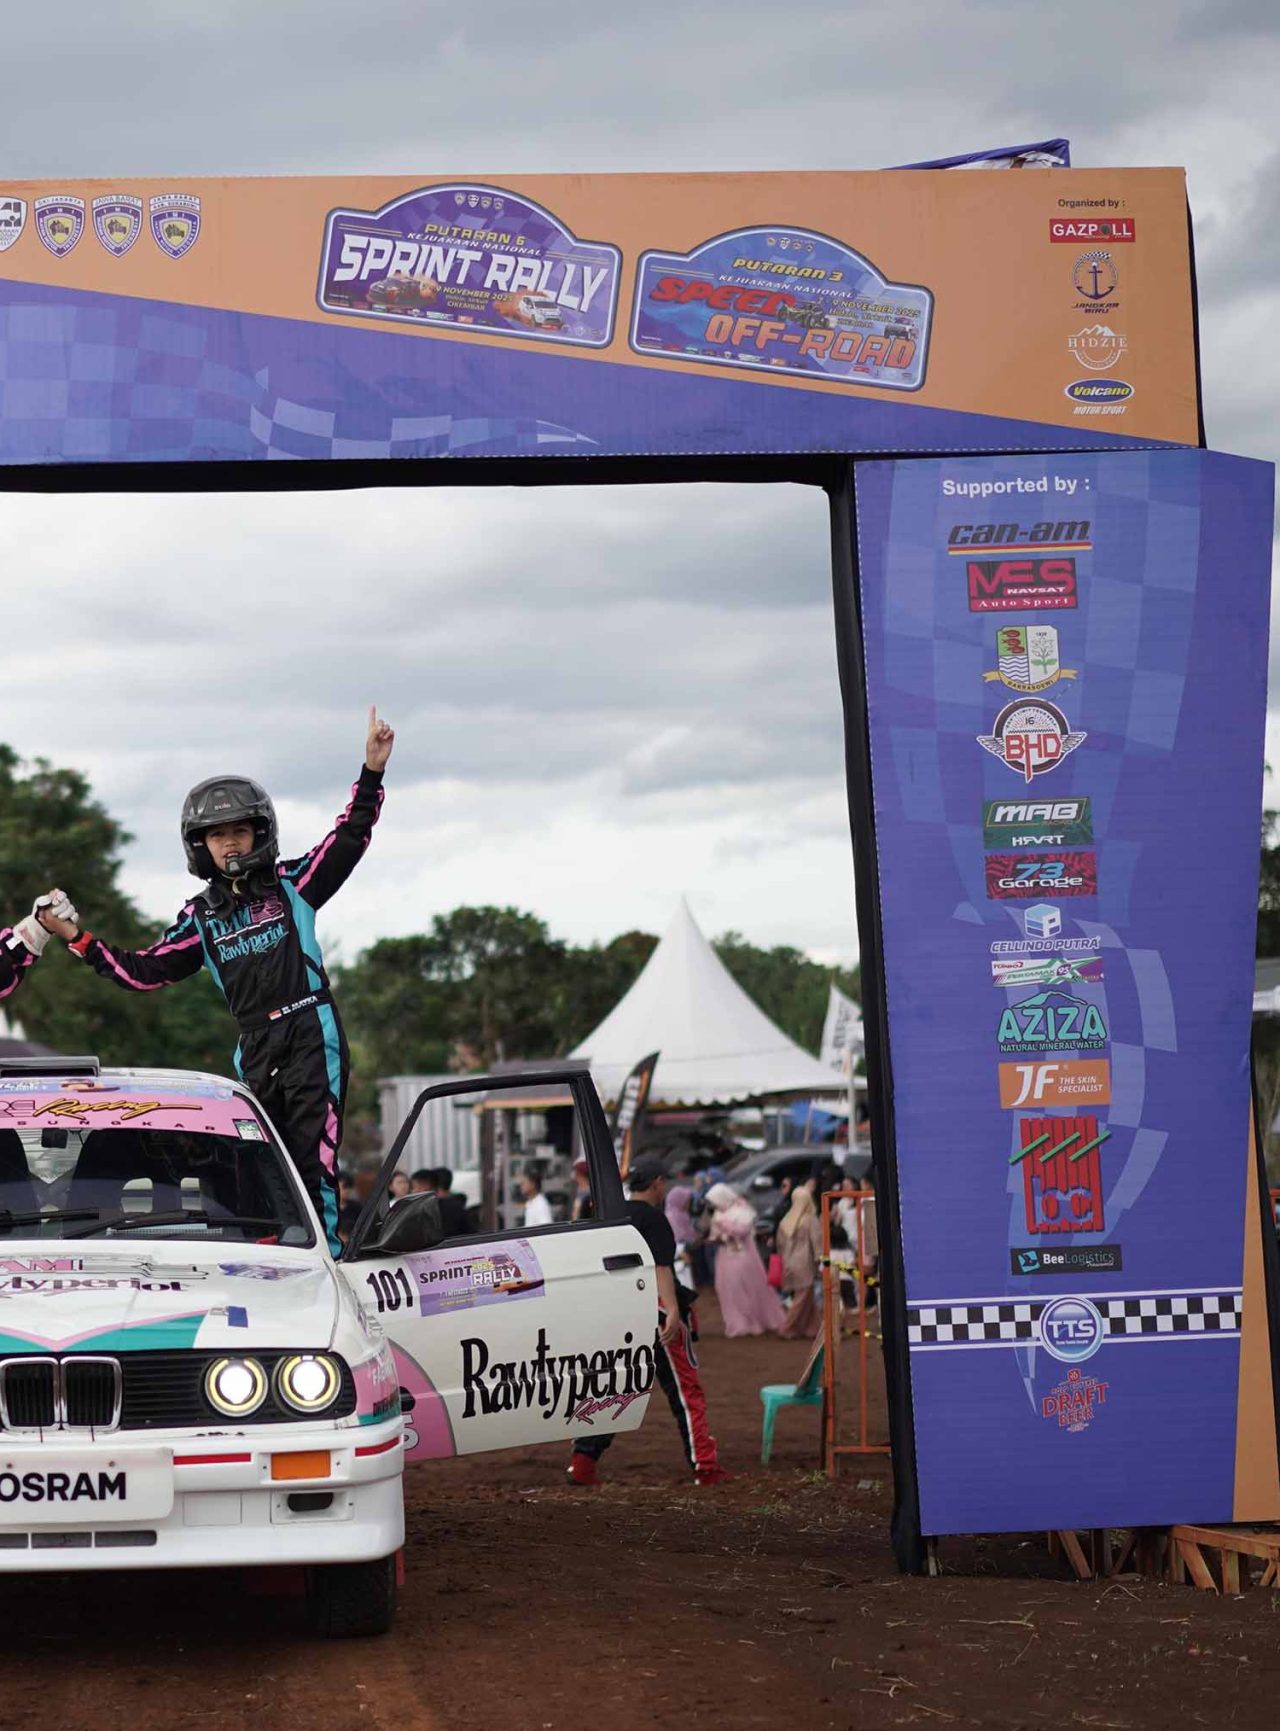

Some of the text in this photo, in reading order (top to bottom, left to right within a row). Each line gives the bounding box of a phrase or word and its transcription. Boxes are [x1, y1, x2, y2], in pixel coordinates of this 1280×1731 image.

[1058, 198, 1106, 208] Organized
[1108, 198, 1119, 208] by
[407, 232, 544, 256] KEJUARAAN NASIONAL
[425, 223, 511, 244] PUTARAN
[333, 233, 609, 313] SPRINT RALLY
[733, 258, 843, 282] PUTARAN 3
[718, 274, 855, 298] KEJUARAAN NASIONAL
[704, 314, 918, 370] OFF-ROAD
[1068, 337, 1128, 347] HIDZIE
[1073, 386, 1130, 396] Volcano
[1073, 405, 1127, 415] MOTOR SPORT
[943, 476, 1048, 498] Supported
[1055, 476, 1077, 495] by
[948, 520, 1091, 545] can-am
[1007, 586, 1067, 594] NAVSAT
[978, 598, 1069, 608] Auto Sport
[1025, 716, 1035, 725] 16
[1004, 733, 1062, 783] BHD
[994, 803, 1078, 822] MAB
[1015, 862, 1065, 880] 73
[999, 876, 1083, 889] Garage
[991, 937, 1100, 953] CELLINDO PUTRA
[997, 1005, 1107, 1043] AZIZA
[1000, 1041, 1104, 1052] NATURAL MINERAL WATER
[1011, 1065, 1059, 1106] JF
[1058, 1084, 1104, 1093] SPECIALIST
[33, 1097, 203, 1121] Racing
[420, 1265, 516, 1286] SPRINT RALLY
[367, 1267, 414, 1313] 101
[1048, 1319, 1095, 1338] TTS
[567, 1390, 651, 1425] Racing
[1042, 1382, 1110, 1418] DRAFT
[1058, 1407, 1095, 1427] BEER
